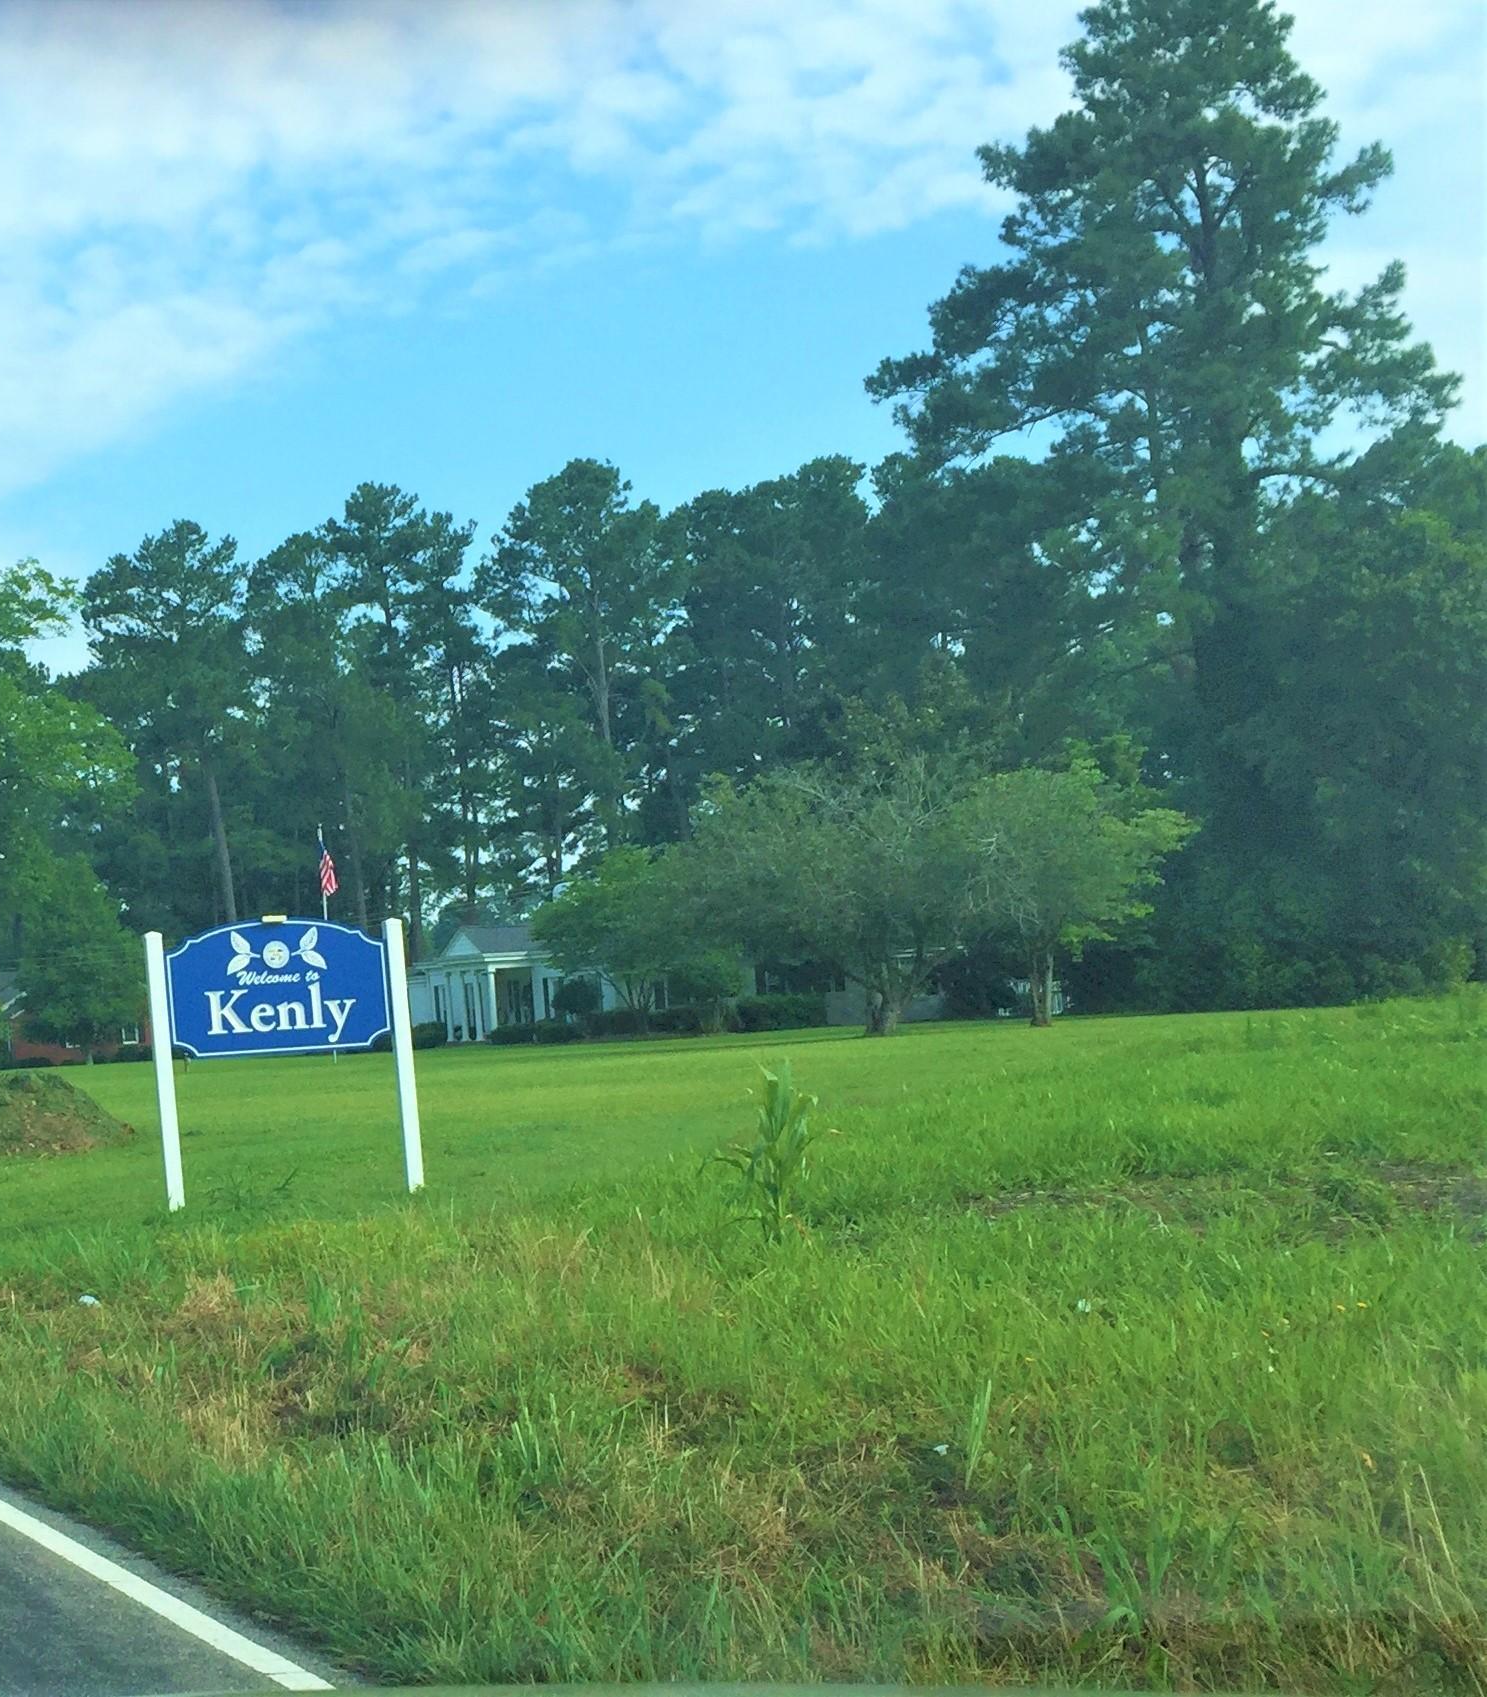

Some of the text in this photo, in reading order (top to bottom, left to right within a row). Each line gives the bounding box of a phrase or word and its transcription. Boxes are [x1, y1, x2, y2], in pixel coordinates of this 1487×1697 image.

[236, 970, 321, 986] Welcome to
[204, 982, 357, 1043] Kenly
